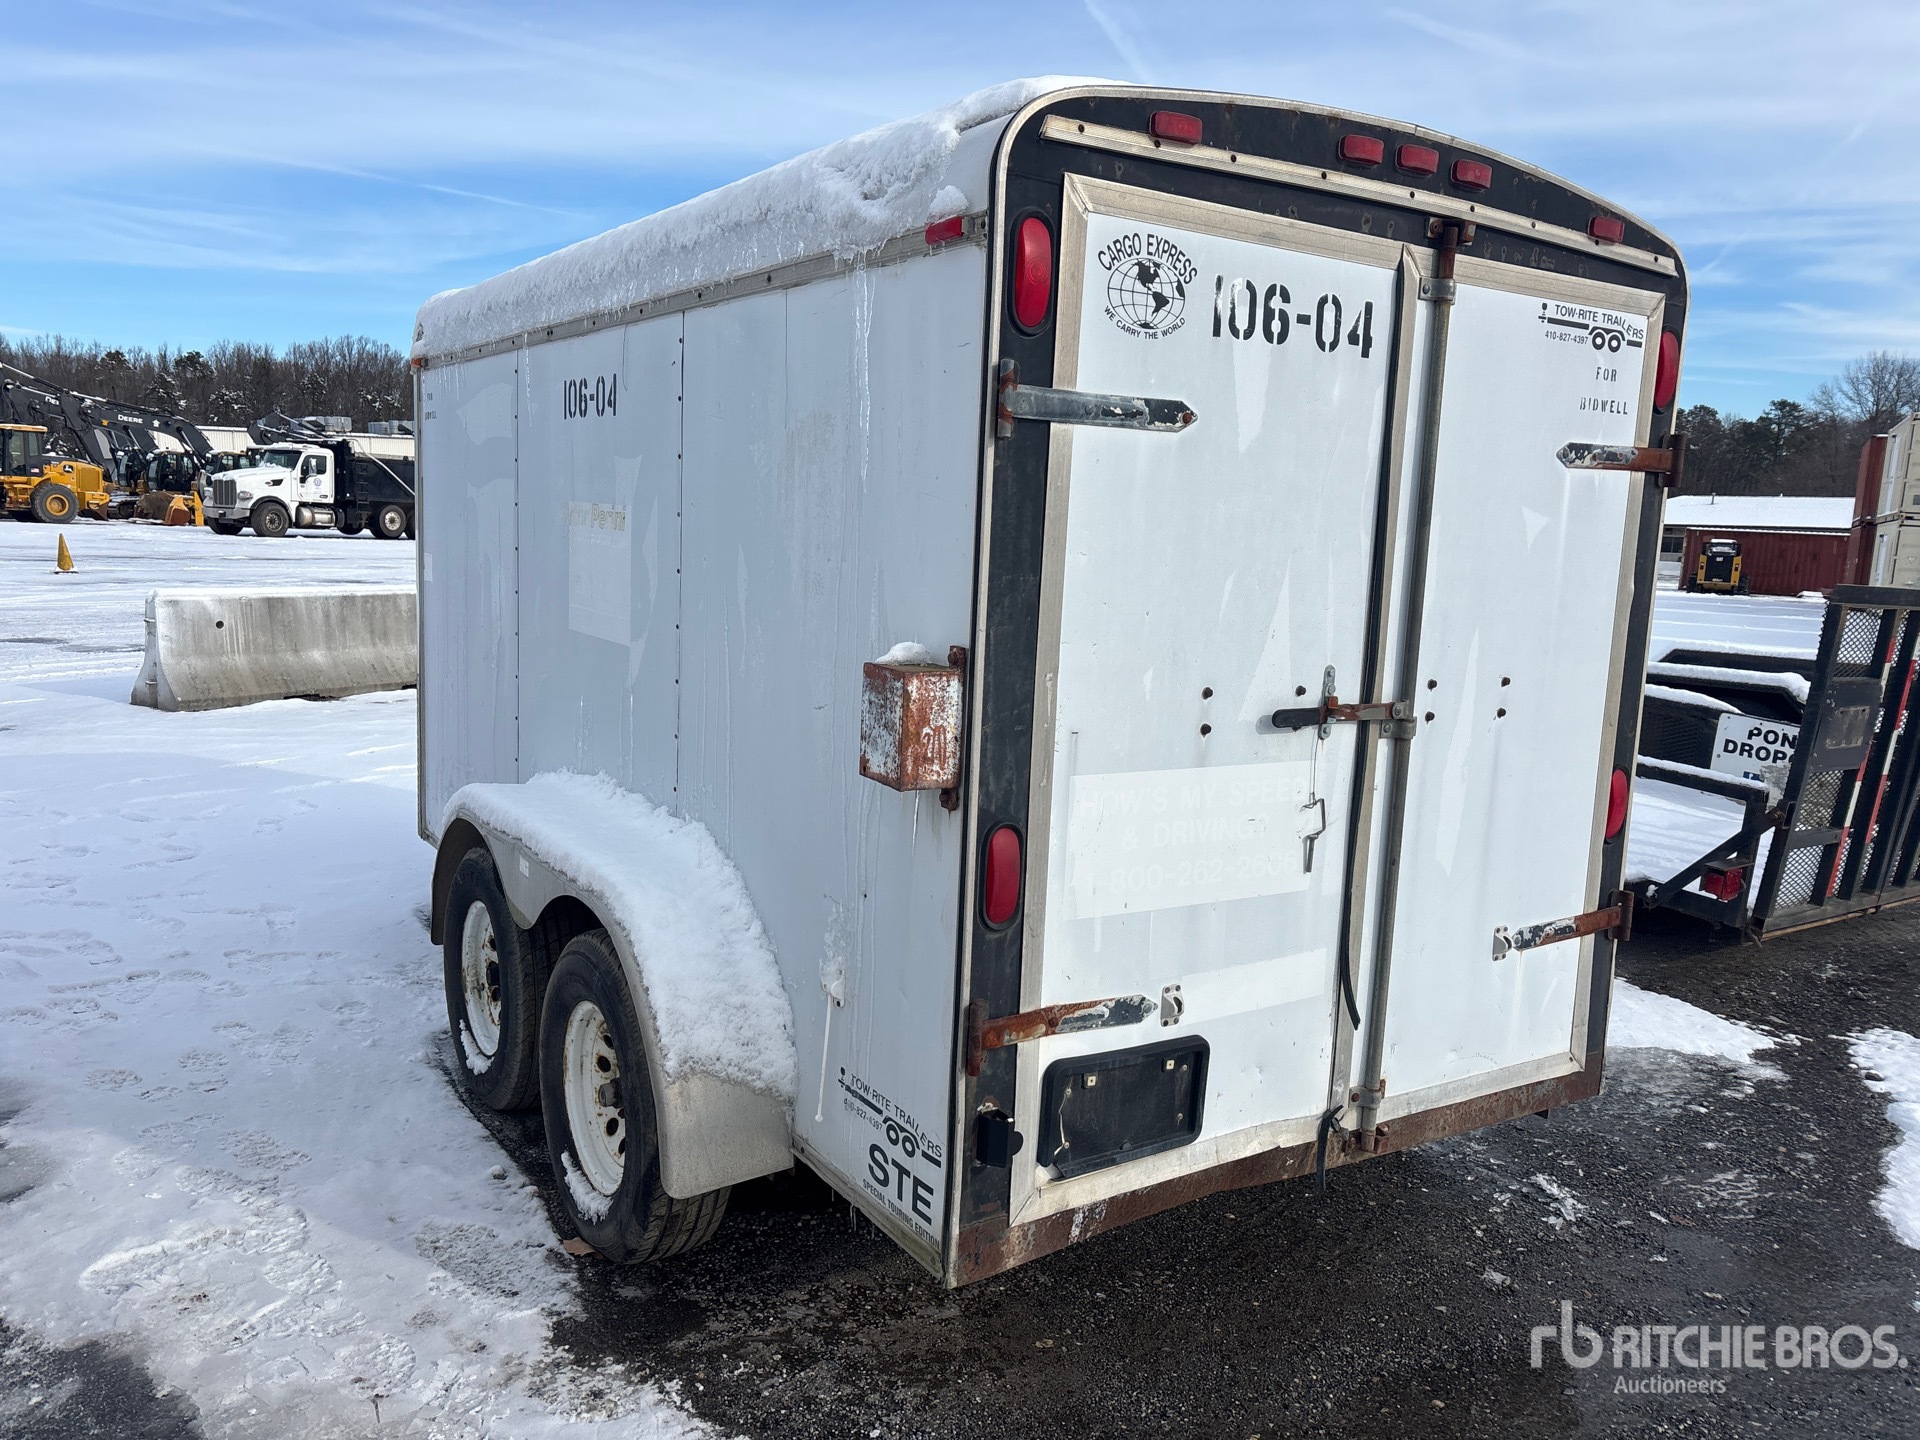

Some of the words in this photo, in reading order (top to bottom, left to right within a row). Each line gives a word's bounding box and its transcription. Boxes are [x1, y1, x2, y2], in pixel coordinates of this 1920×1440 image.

[1097, 232, 1142, 271] CARGO
[1146, 233, 1198, 285] EXPRESS
[1104, 305, 1116, 322] WE
[1116, 319, 1142, 338] CARRY
[1143, 331, 1159, 340] THE
[1160, 317, 1186, 338] WORLD
[1212, 273, 1374, 359] 106-04
[1601, 312, 1645, 340] TRAILERS
[1544, 329, 1589, 345] 410-827-4397
[1595, 366, 1618, 383] FOR
[563, 373, 617, 420] 106-04
[117, 414, 144, 424] DEERE
[1179, 782, 1218, 810] MY
[1229, 776, 1308, 808] SPEED
[893, 1104, 943, 1159] TRAILERS
[867, 1143, 934, 1226] STE
[862, 1178, 888, 1207] SPECIAL
[887, 1198, 914, 1230] TOURING
[914, 1222, 941, 1251] EDITION
